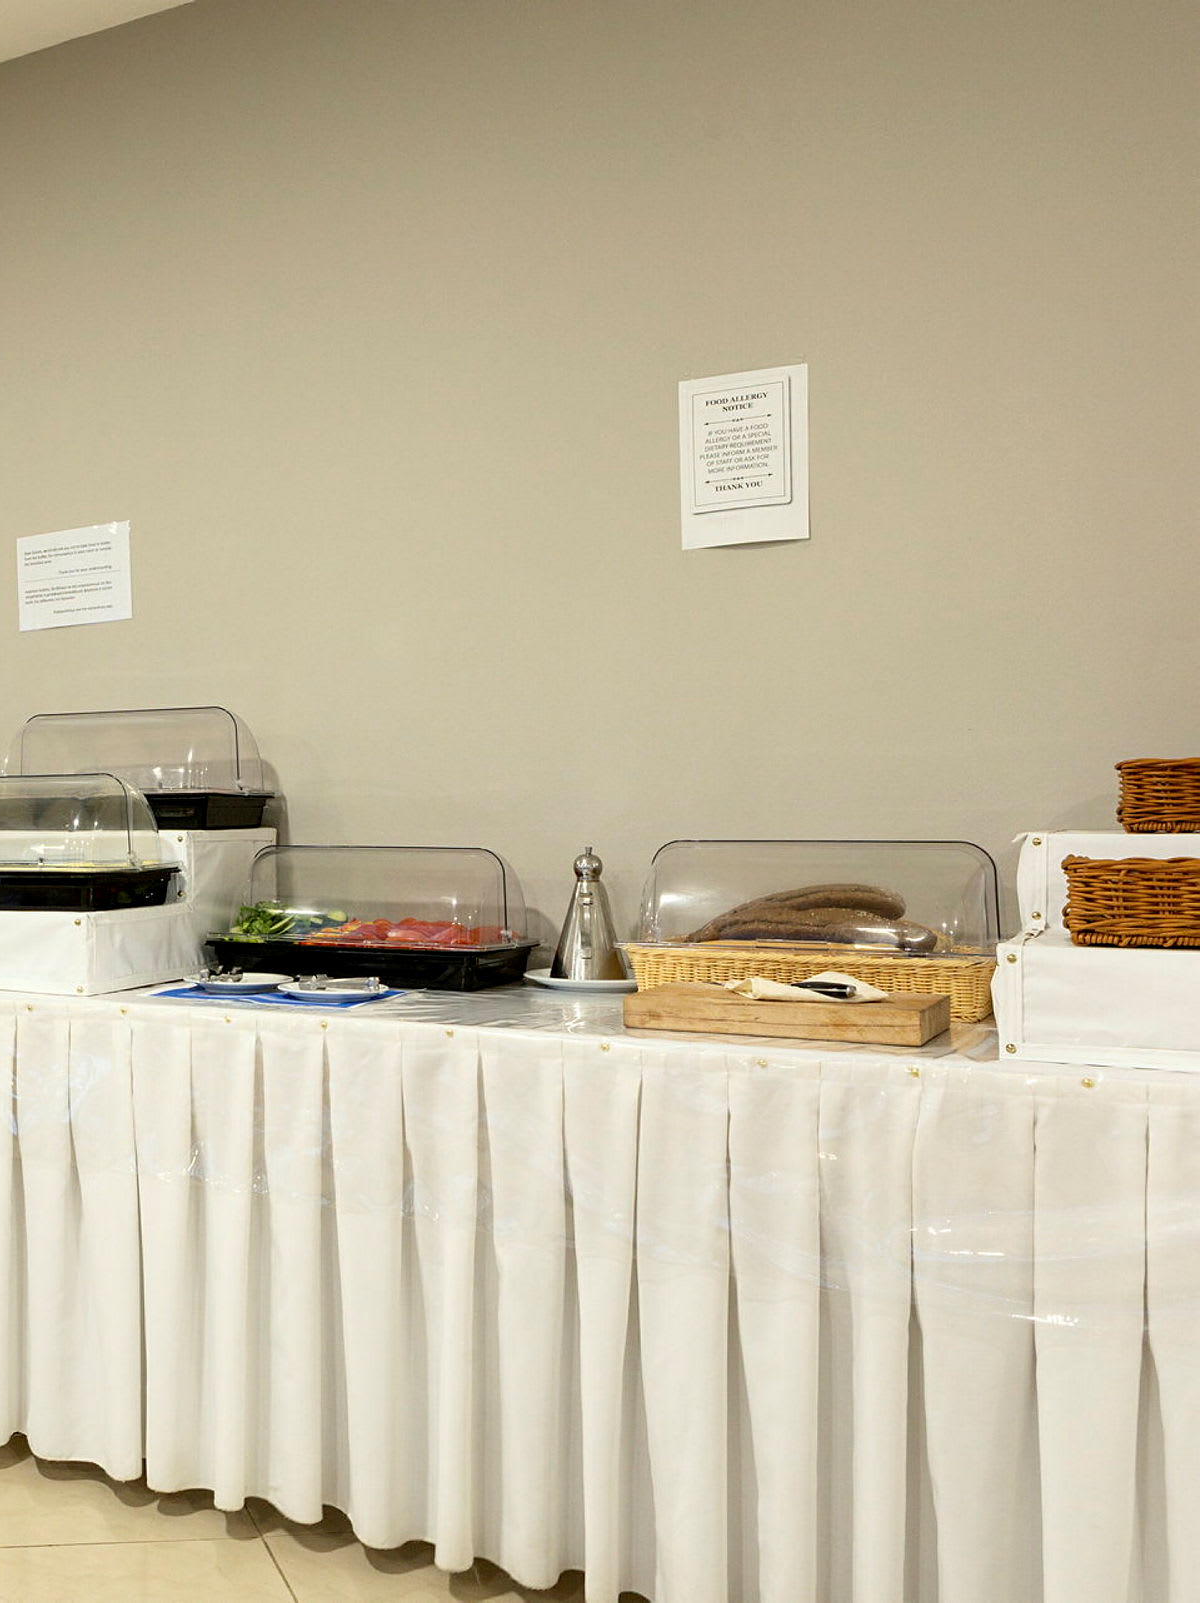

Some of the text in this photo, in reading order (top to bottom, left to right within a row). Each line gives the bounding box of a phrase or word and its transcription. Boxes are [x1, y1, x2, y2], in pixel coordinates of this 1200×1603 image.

[705, 391, 768, 406] FOOD ALLERGY
[722, 402, 753, 412] NOTICE
[704, 436, 730, 444] ALLERGY
[748, 430, 772, 438] SPECIAL
[700, 452, 720, 460] PLEASE
[752, 445, 778, 453] MEMBER
[704, 444, 728, 452] DIETARY
[715, 480, 763, 492] THANK YOU
